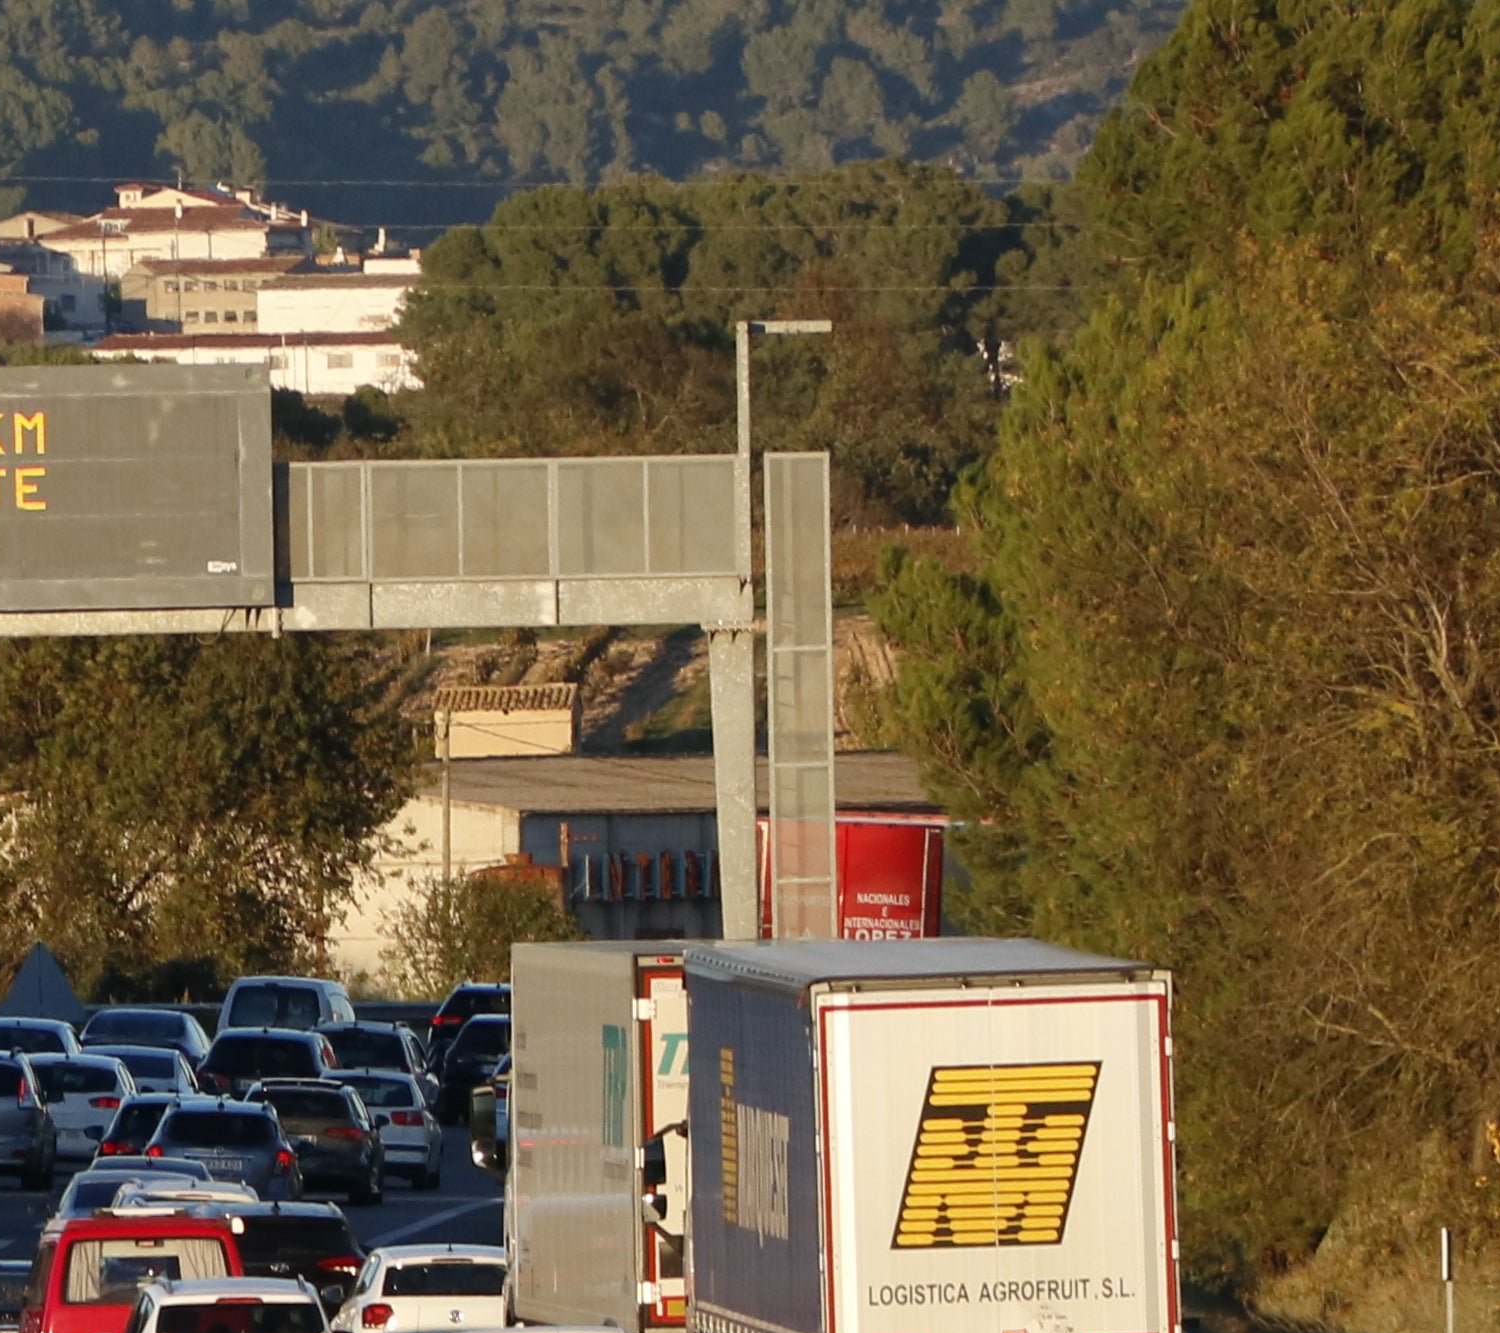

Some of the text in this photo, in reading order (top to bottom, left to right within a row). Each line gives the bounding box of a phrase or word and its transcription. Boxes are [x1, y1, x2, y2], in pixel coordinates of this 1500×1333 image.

[856, 893, 911, 906] NACIONALES
[844, 917, 921, 931] INTERNACIONALES
[868, 1282, 969, 1306] LOGISTICA
